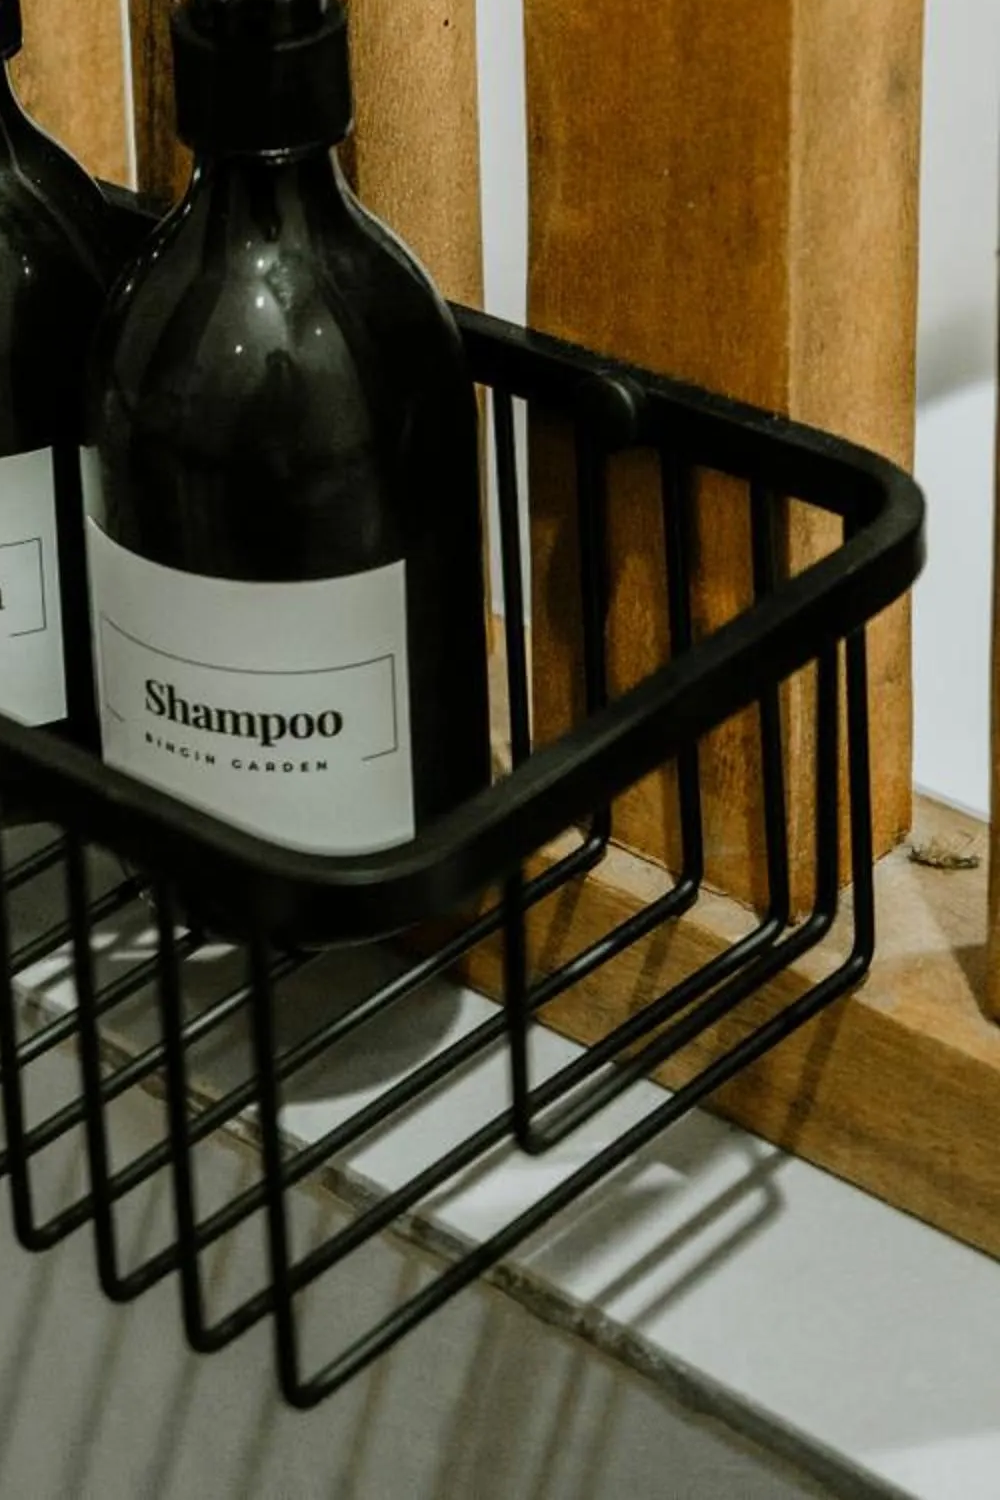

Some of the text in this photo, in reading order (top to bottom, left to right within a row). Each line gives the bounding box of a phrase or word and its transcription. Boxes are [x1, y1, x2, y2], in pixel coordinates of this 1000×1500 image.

[145, 679, 344, 747] Shampoo
[145, 732, 328, 773] BINGIN GARDEN
